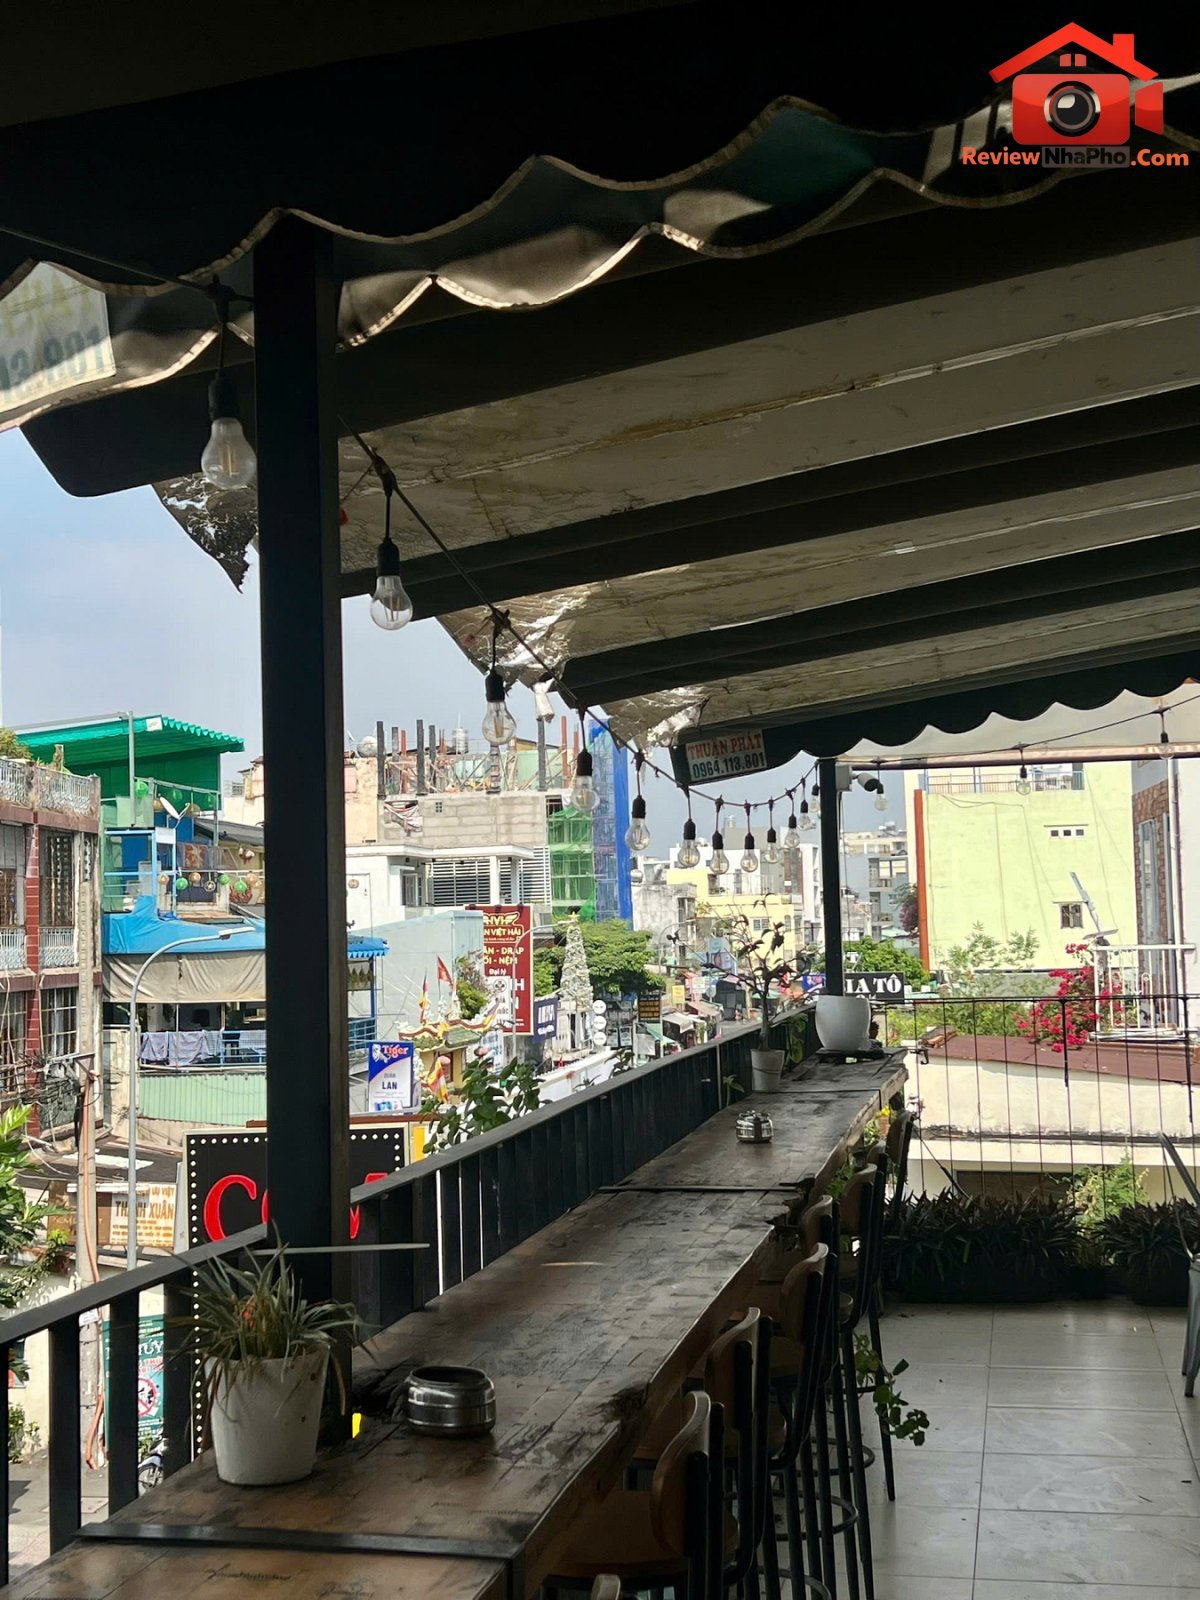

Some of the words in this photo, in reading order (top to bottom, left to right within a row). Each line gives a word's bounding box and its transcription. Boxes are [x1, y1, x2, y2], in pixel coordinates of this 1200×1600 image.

[693, 752, 765, 779] 0964.113.801
[873, 973, 902, 993] TÔ
[382, 1045, 409, 1058] Tiger
[382, 1081, 398, 1090] LAN
